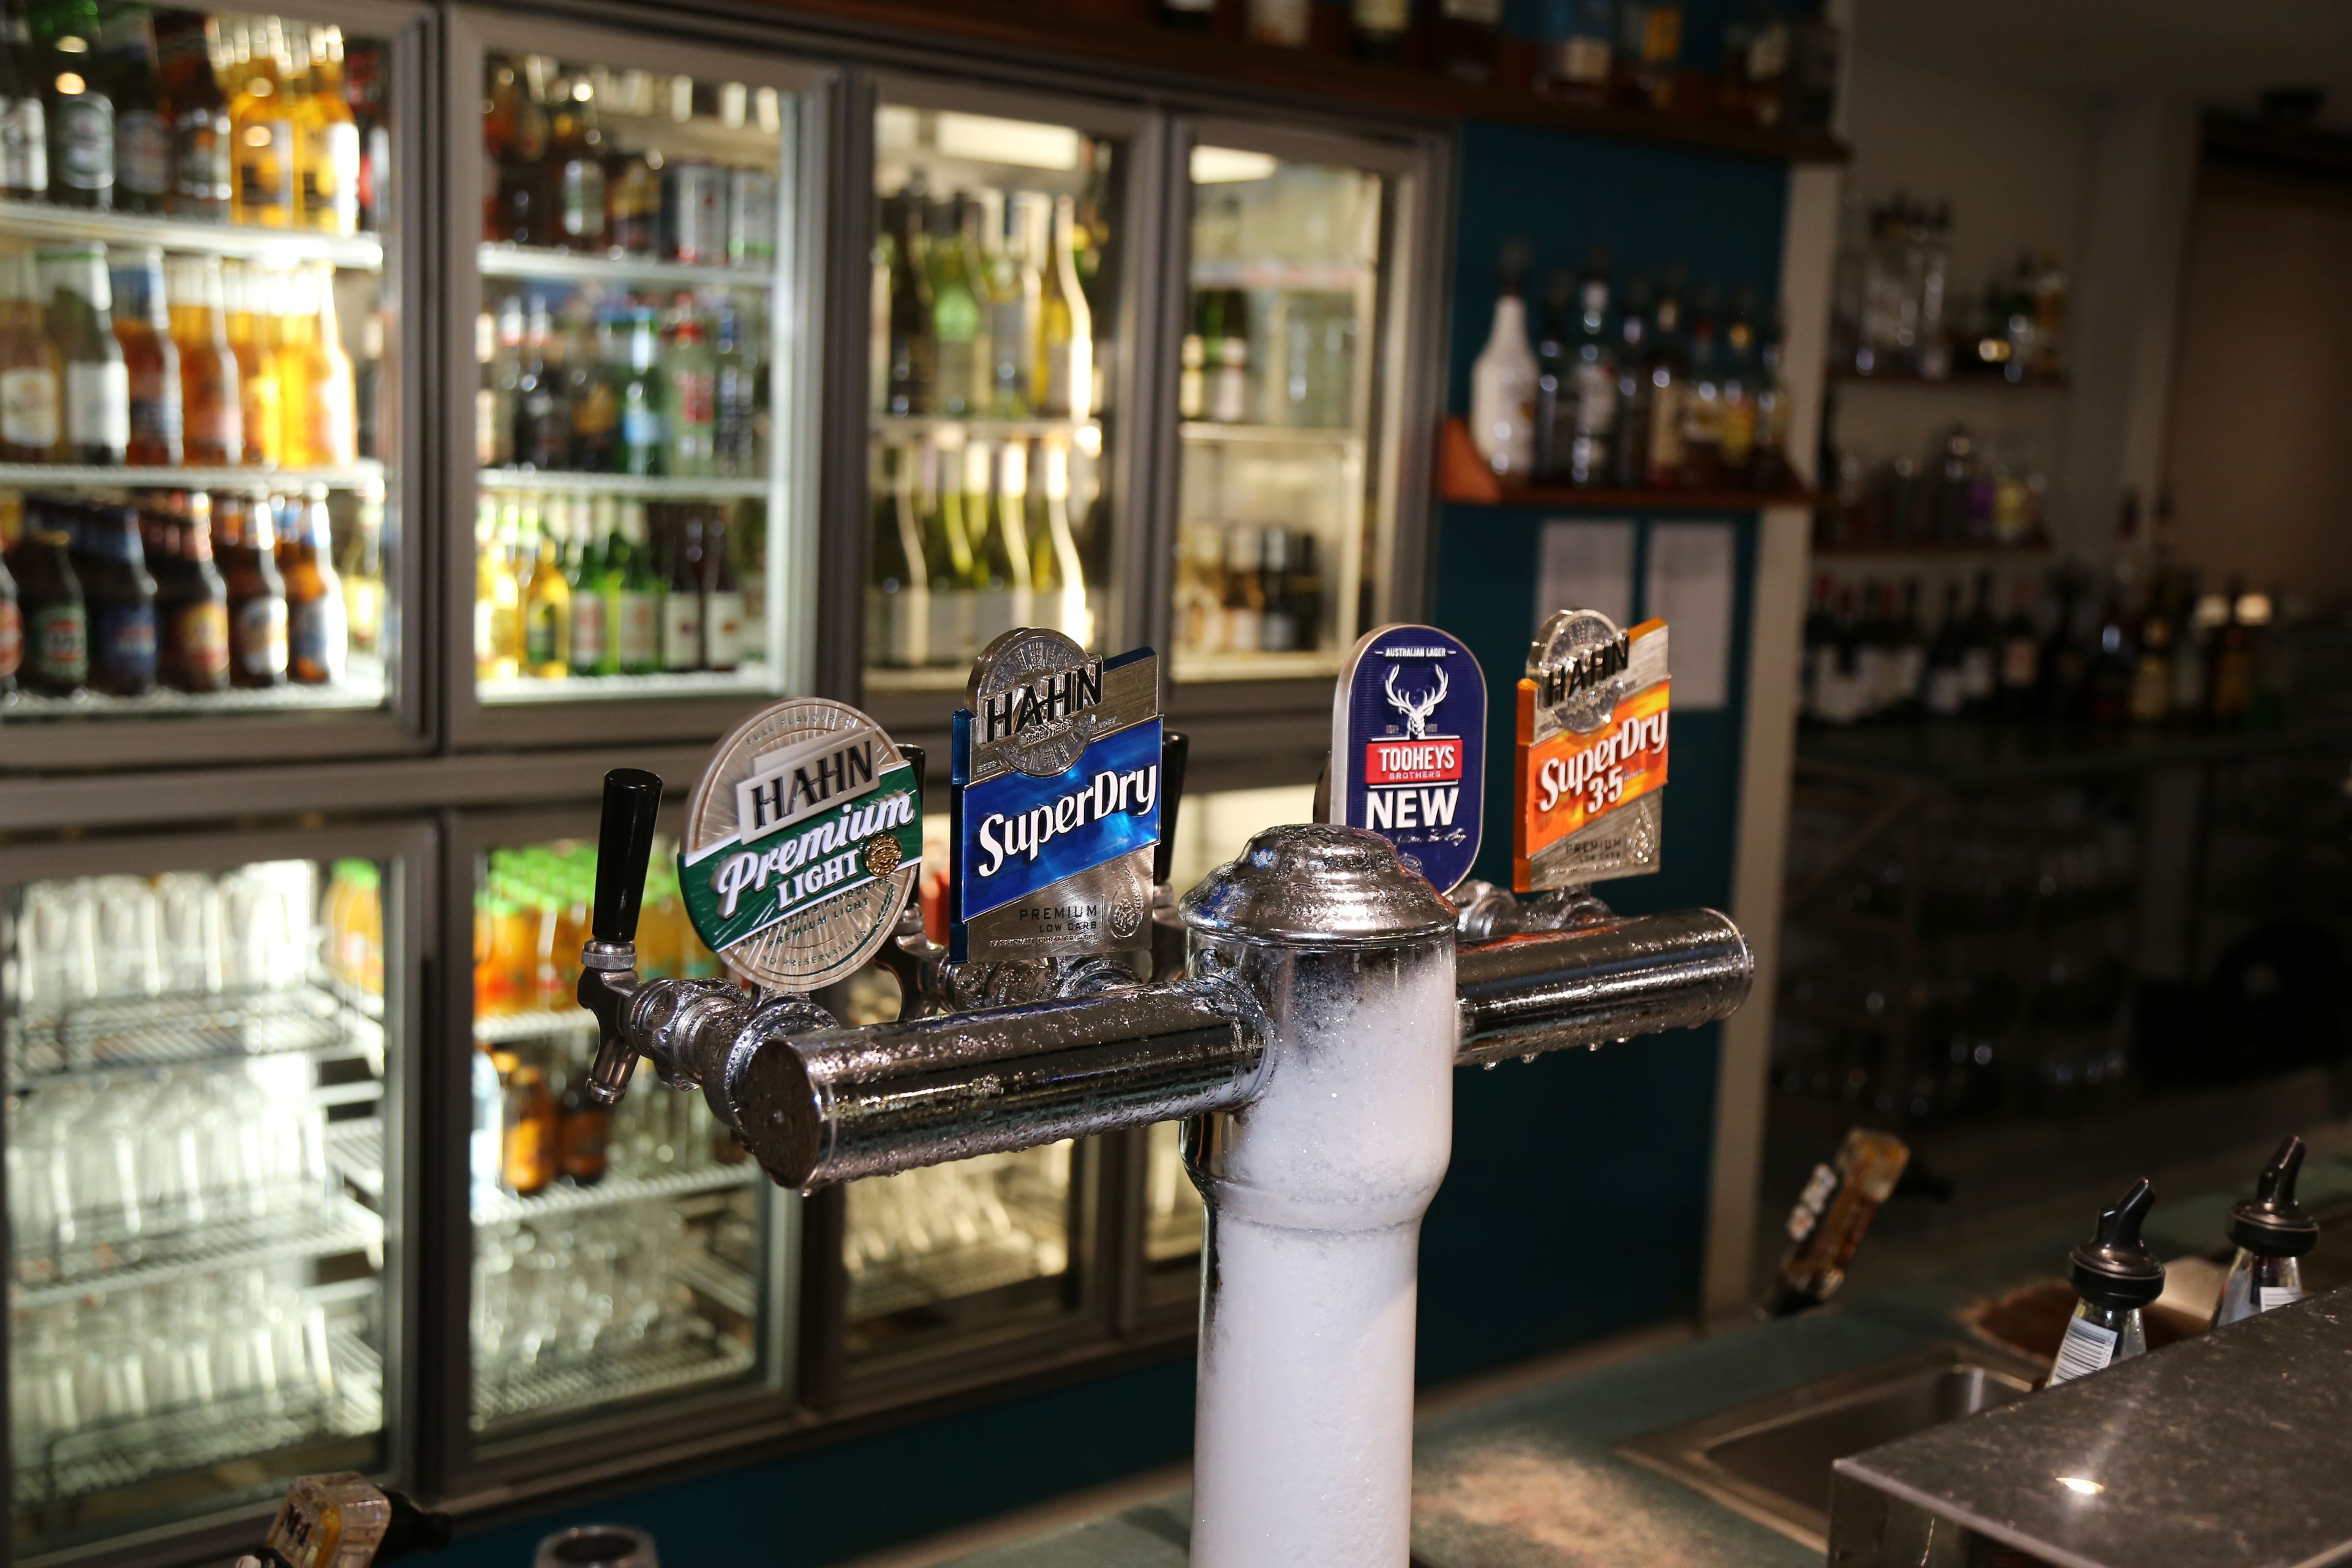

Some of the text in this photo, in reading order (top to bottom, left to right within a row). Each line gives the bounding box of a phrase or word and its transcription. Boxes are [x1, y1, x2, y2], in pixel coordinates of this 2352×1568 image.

[1385, 647, 1446, 657] AUSTRALIAN LAGER
[1547, 636, 1630, 707] HAHN
[986, 660, 1104, 744] HAHN
[751, 740, 875, 831] HAHN
[1379, 745, 1455, 772] TOOHEYS
[1389, 771, 1441, 780] BROTHERS
[1539, 710, 1668, 813] SuperDry
[978, 764, 1157, 877] SuperDry
[1365, 787, 1460, 830] NEW
[714, 793, 916, 921] Premium
[776, 849, 861, 910] LIGHT
[767, 896, 870, 949] PREMIUM LIGHT
[1019, 905, 1097, 922] PREMIUM
[1039, 921, 1097, 933] LOW CARB
